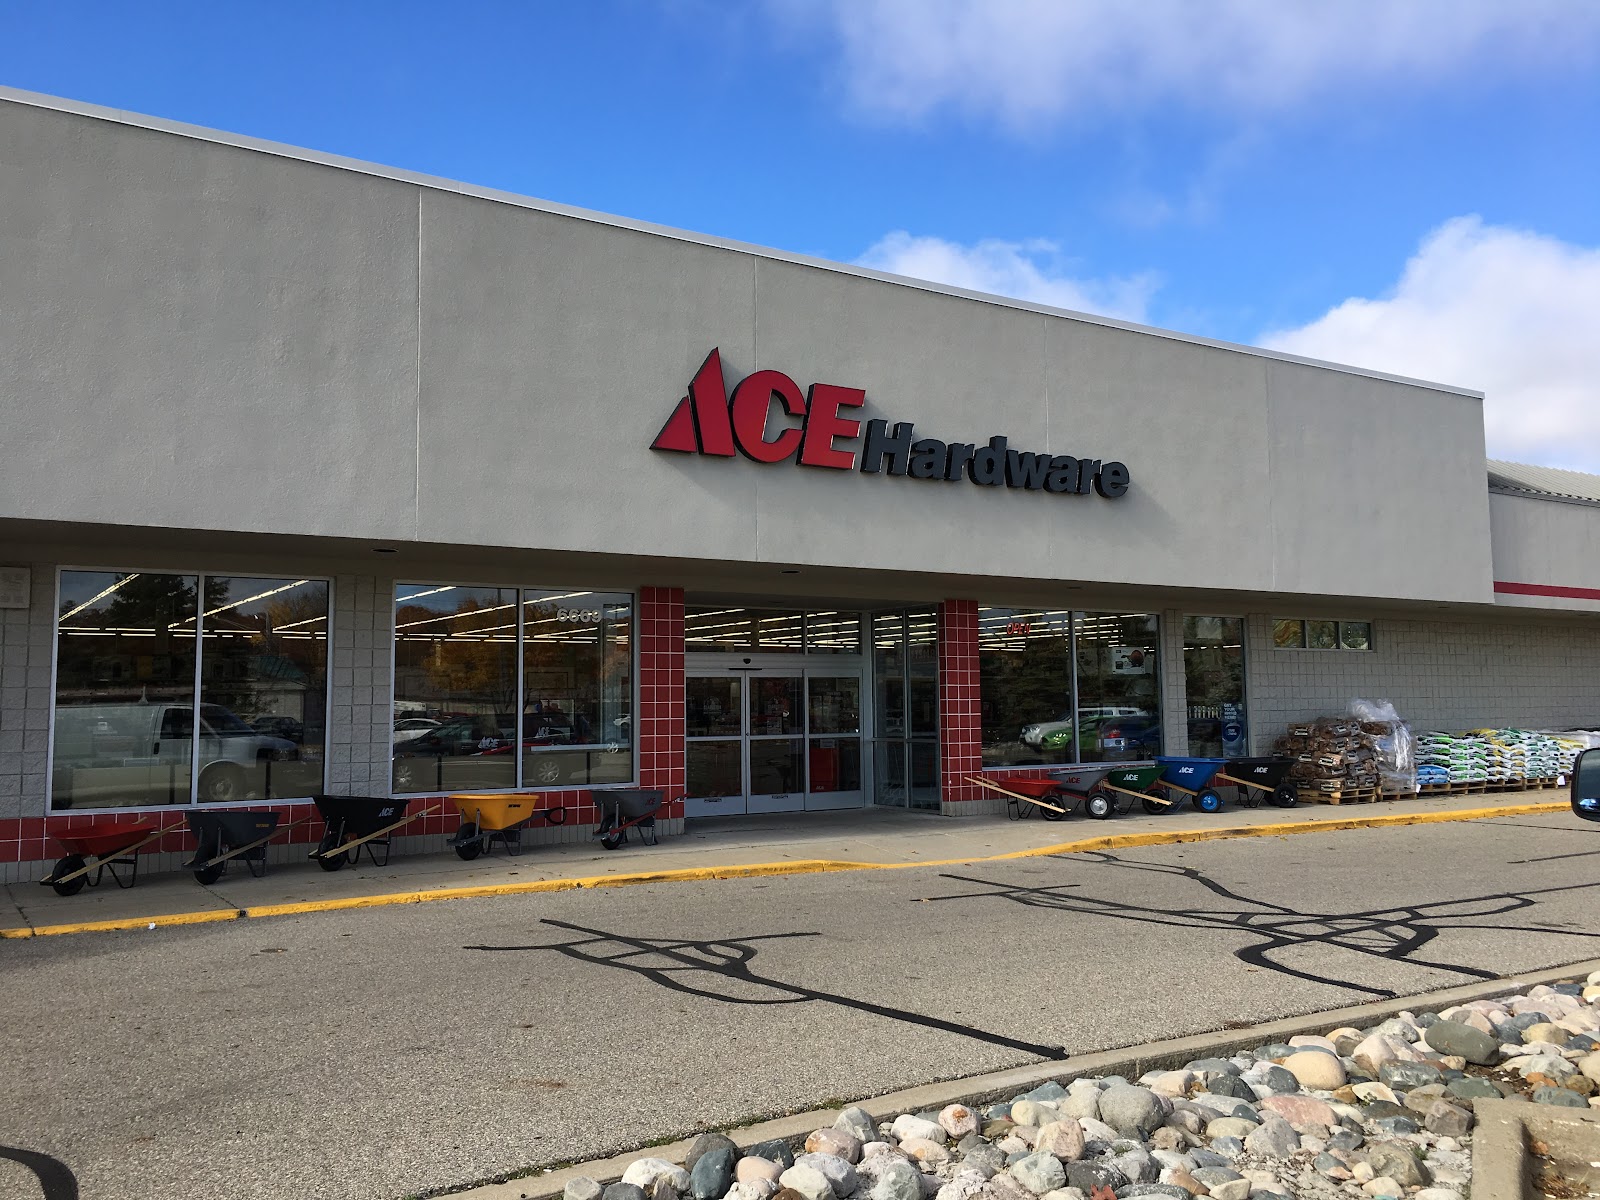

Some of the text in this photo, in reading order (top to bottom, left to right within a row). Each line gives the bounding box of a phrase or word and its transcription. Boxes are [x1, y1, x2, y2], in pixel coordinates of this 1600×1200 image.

[649, 346, 1130, 499] ACE Hardware
[1006, 622, 1031, 635] OPEN
[478, 736, 500, 748] ACE
[1178, 766, 1195, 774] ACE
[1254, 766, 1269, 774] ACE
[1066, 776, 1081, 784] ACE
[1122, 773, 1139, 781] ACE
[378, 807, 395, 817] ACE
